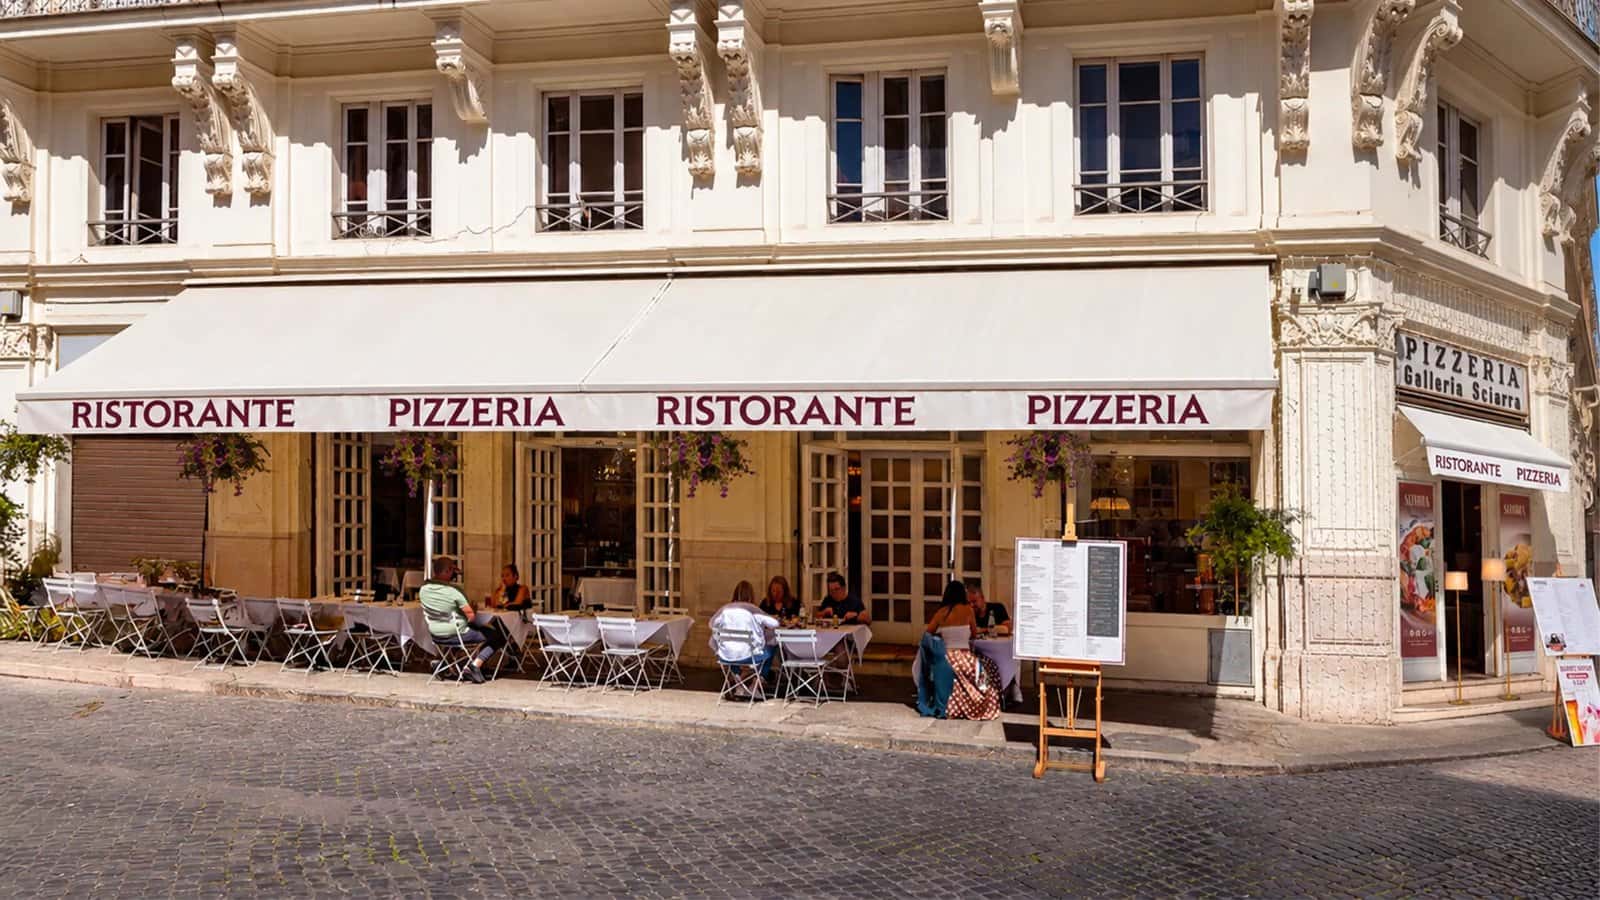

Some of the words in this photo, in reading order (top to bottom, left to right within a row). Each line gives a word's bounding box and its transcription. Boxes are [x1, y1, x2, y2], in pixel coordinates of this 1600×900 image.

[1405, 336, 1521, 389] PIZZERIA
[1404, 364, 1463, 397] Galleria
[1472, 381, 1521, 410] Sciarra
[72, 398, 295, 429] RISTORANTE
[389, 397, 565, 427] PIZZERIA
[657, 395, 917, 426] RISTORANTE
[1028, 394, 1209, 425] PIZZERIA
[1435, 455, 1502, 478] RISTORANTE
[1516, 467, 1562, 487] PIZZERIA
